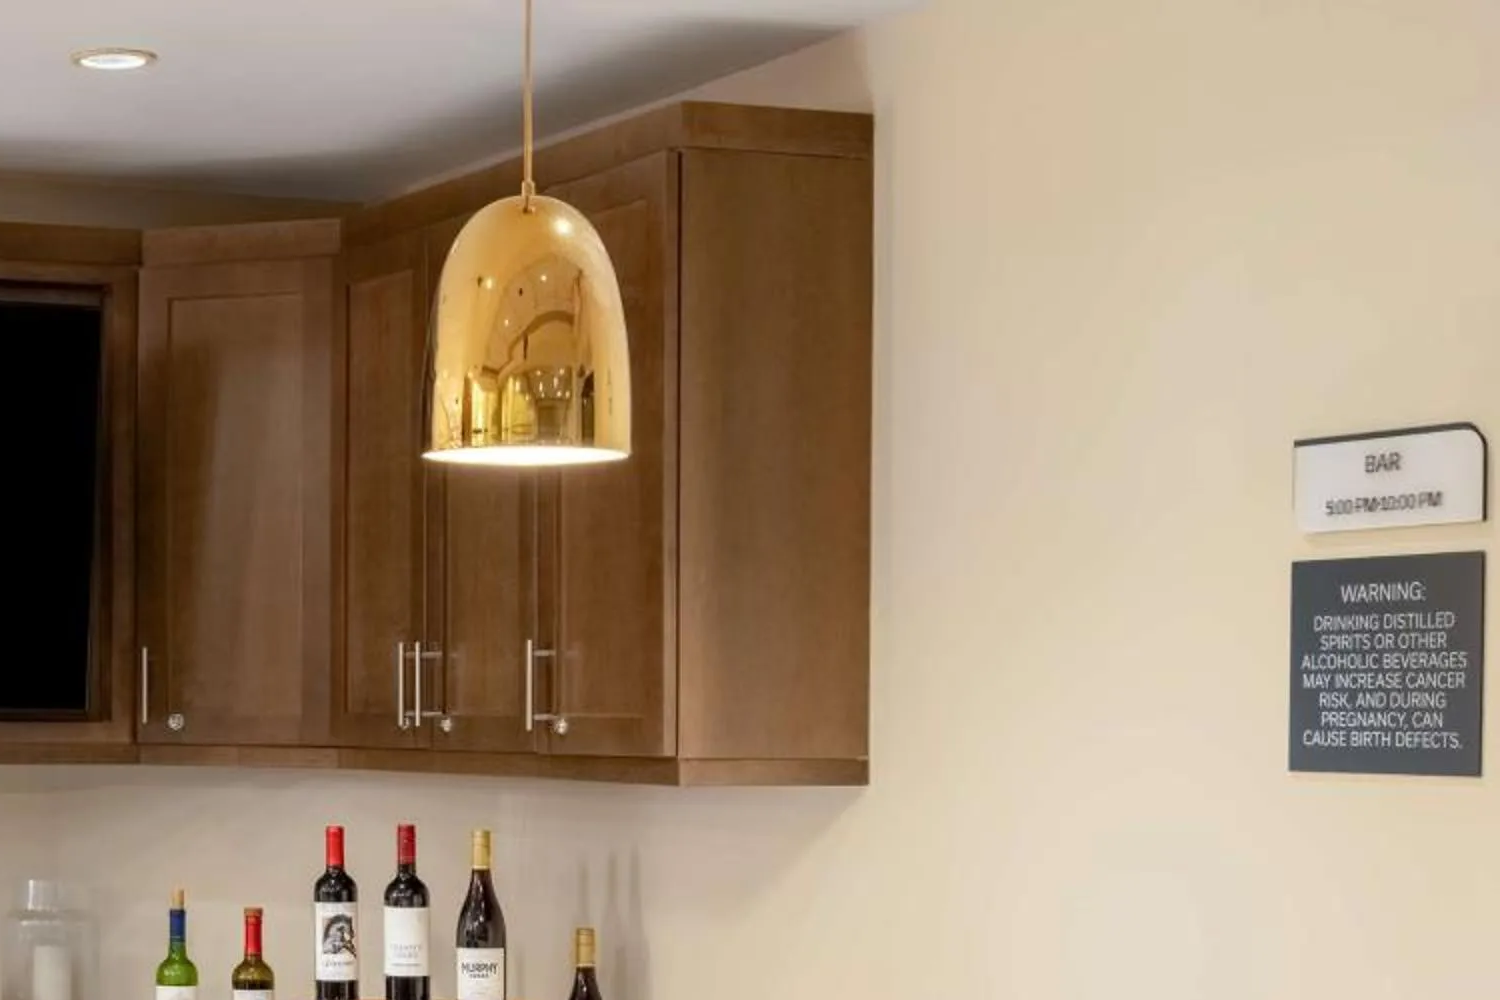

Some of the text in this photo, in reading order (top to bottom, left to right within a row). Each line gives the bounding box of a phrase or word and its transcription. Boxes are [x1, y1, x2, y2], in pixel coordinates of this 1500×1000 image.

[1364, 452, 1401, 473] BAR
[1418, 491, 1444, 508] PM
[1340, 581, 1427, 604] WARNING:
[1313, 611, 1456, 632] DRINKING DISTILLED
[1319, 631, 1448, 651] SPIRITS OR OTHER
[1301, 651, 1468, 670] ALCOHOLIC BEVERAGES
[1302, 671, 1466, 689] MAY INCREASE CANCER
[1355, 691, 1387, 708] AND
[1389, 691, 1447, 709] DURING
[1321, 711, 1444, 730] PREGNANCY, CAN
[1303, 730, 1463, 749] CAUSE BIRTH DEFECTS.
